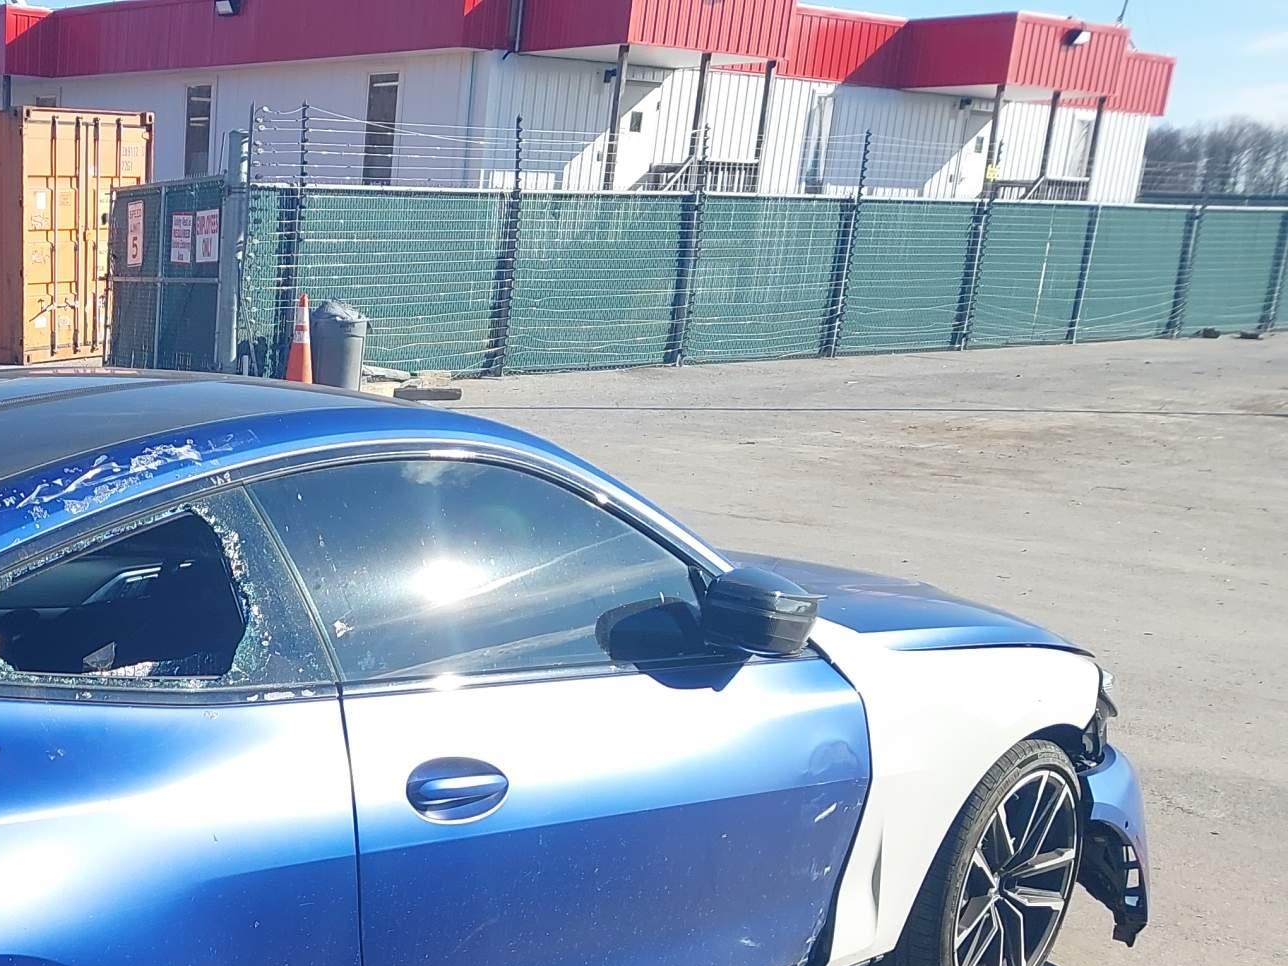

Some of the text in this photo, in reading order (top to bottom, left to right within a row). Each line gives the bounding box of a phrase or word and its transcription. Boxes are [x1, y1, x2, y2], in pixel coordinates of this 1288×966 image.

[196, 214, 219, 236] EMPLOYEES
[132, 236, 138, 259] 5
[202, 238, 212, 257] ONLY
